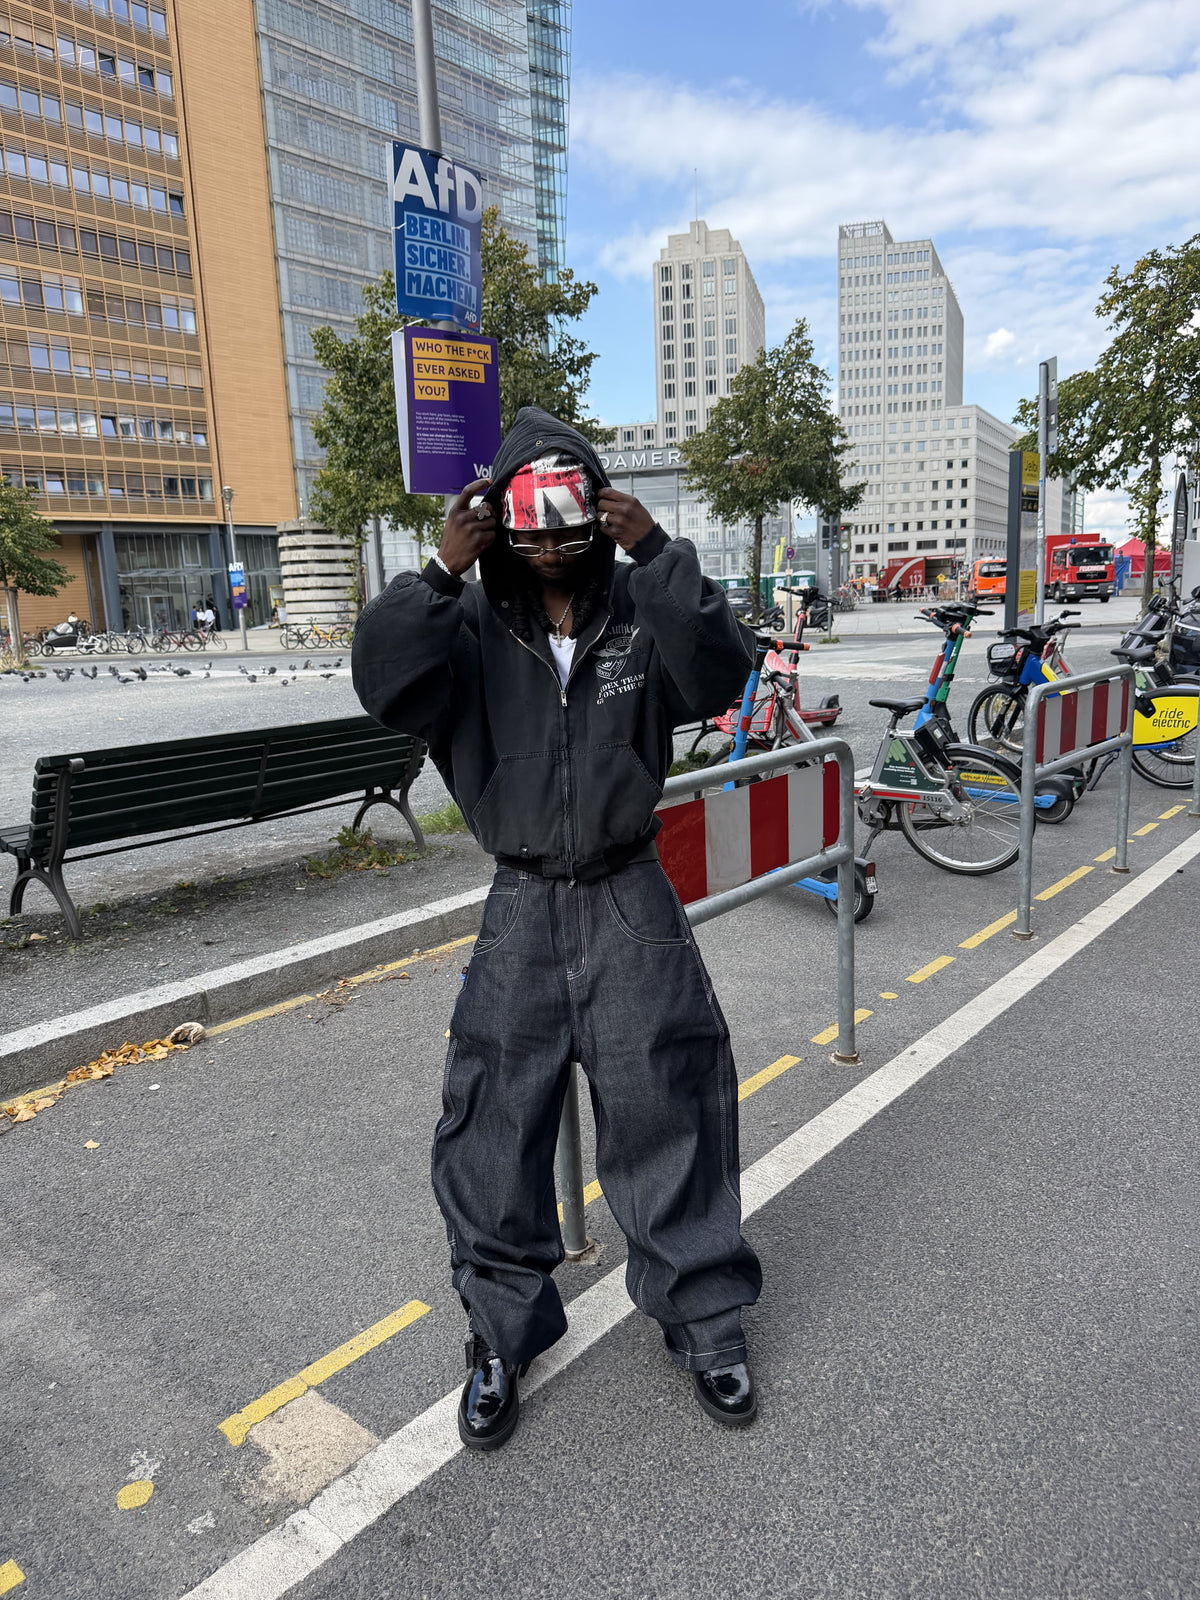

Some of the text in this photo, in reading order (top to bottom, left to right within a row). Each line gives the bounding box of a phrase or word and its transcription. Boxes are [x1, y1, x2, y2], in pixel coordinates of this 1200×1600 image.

[393, 149, 482, 223] AfD
[405, 213, 469, 252] BERLIN.
[406, 243, 469, 279] SICHER.
[407, 272, 475, 308] MACHEN.
[464, 311, 477, 323] AfD
[415, 341, 442, 353] WHO
[445, 344, 464, 356] THE
[417, 363, 480, 379] EVER ASKED
[418, 385, 446, 397] YOU?
[600, 450, 681, 470] DAMER
[473, 463, 493, 478] Vol
[909, 574, 922, 586] 112
[620, 673, 645, 684] TEAM
[1159, 708, 1184, 719] ride
[1152, 718, 1190, 728] electric
